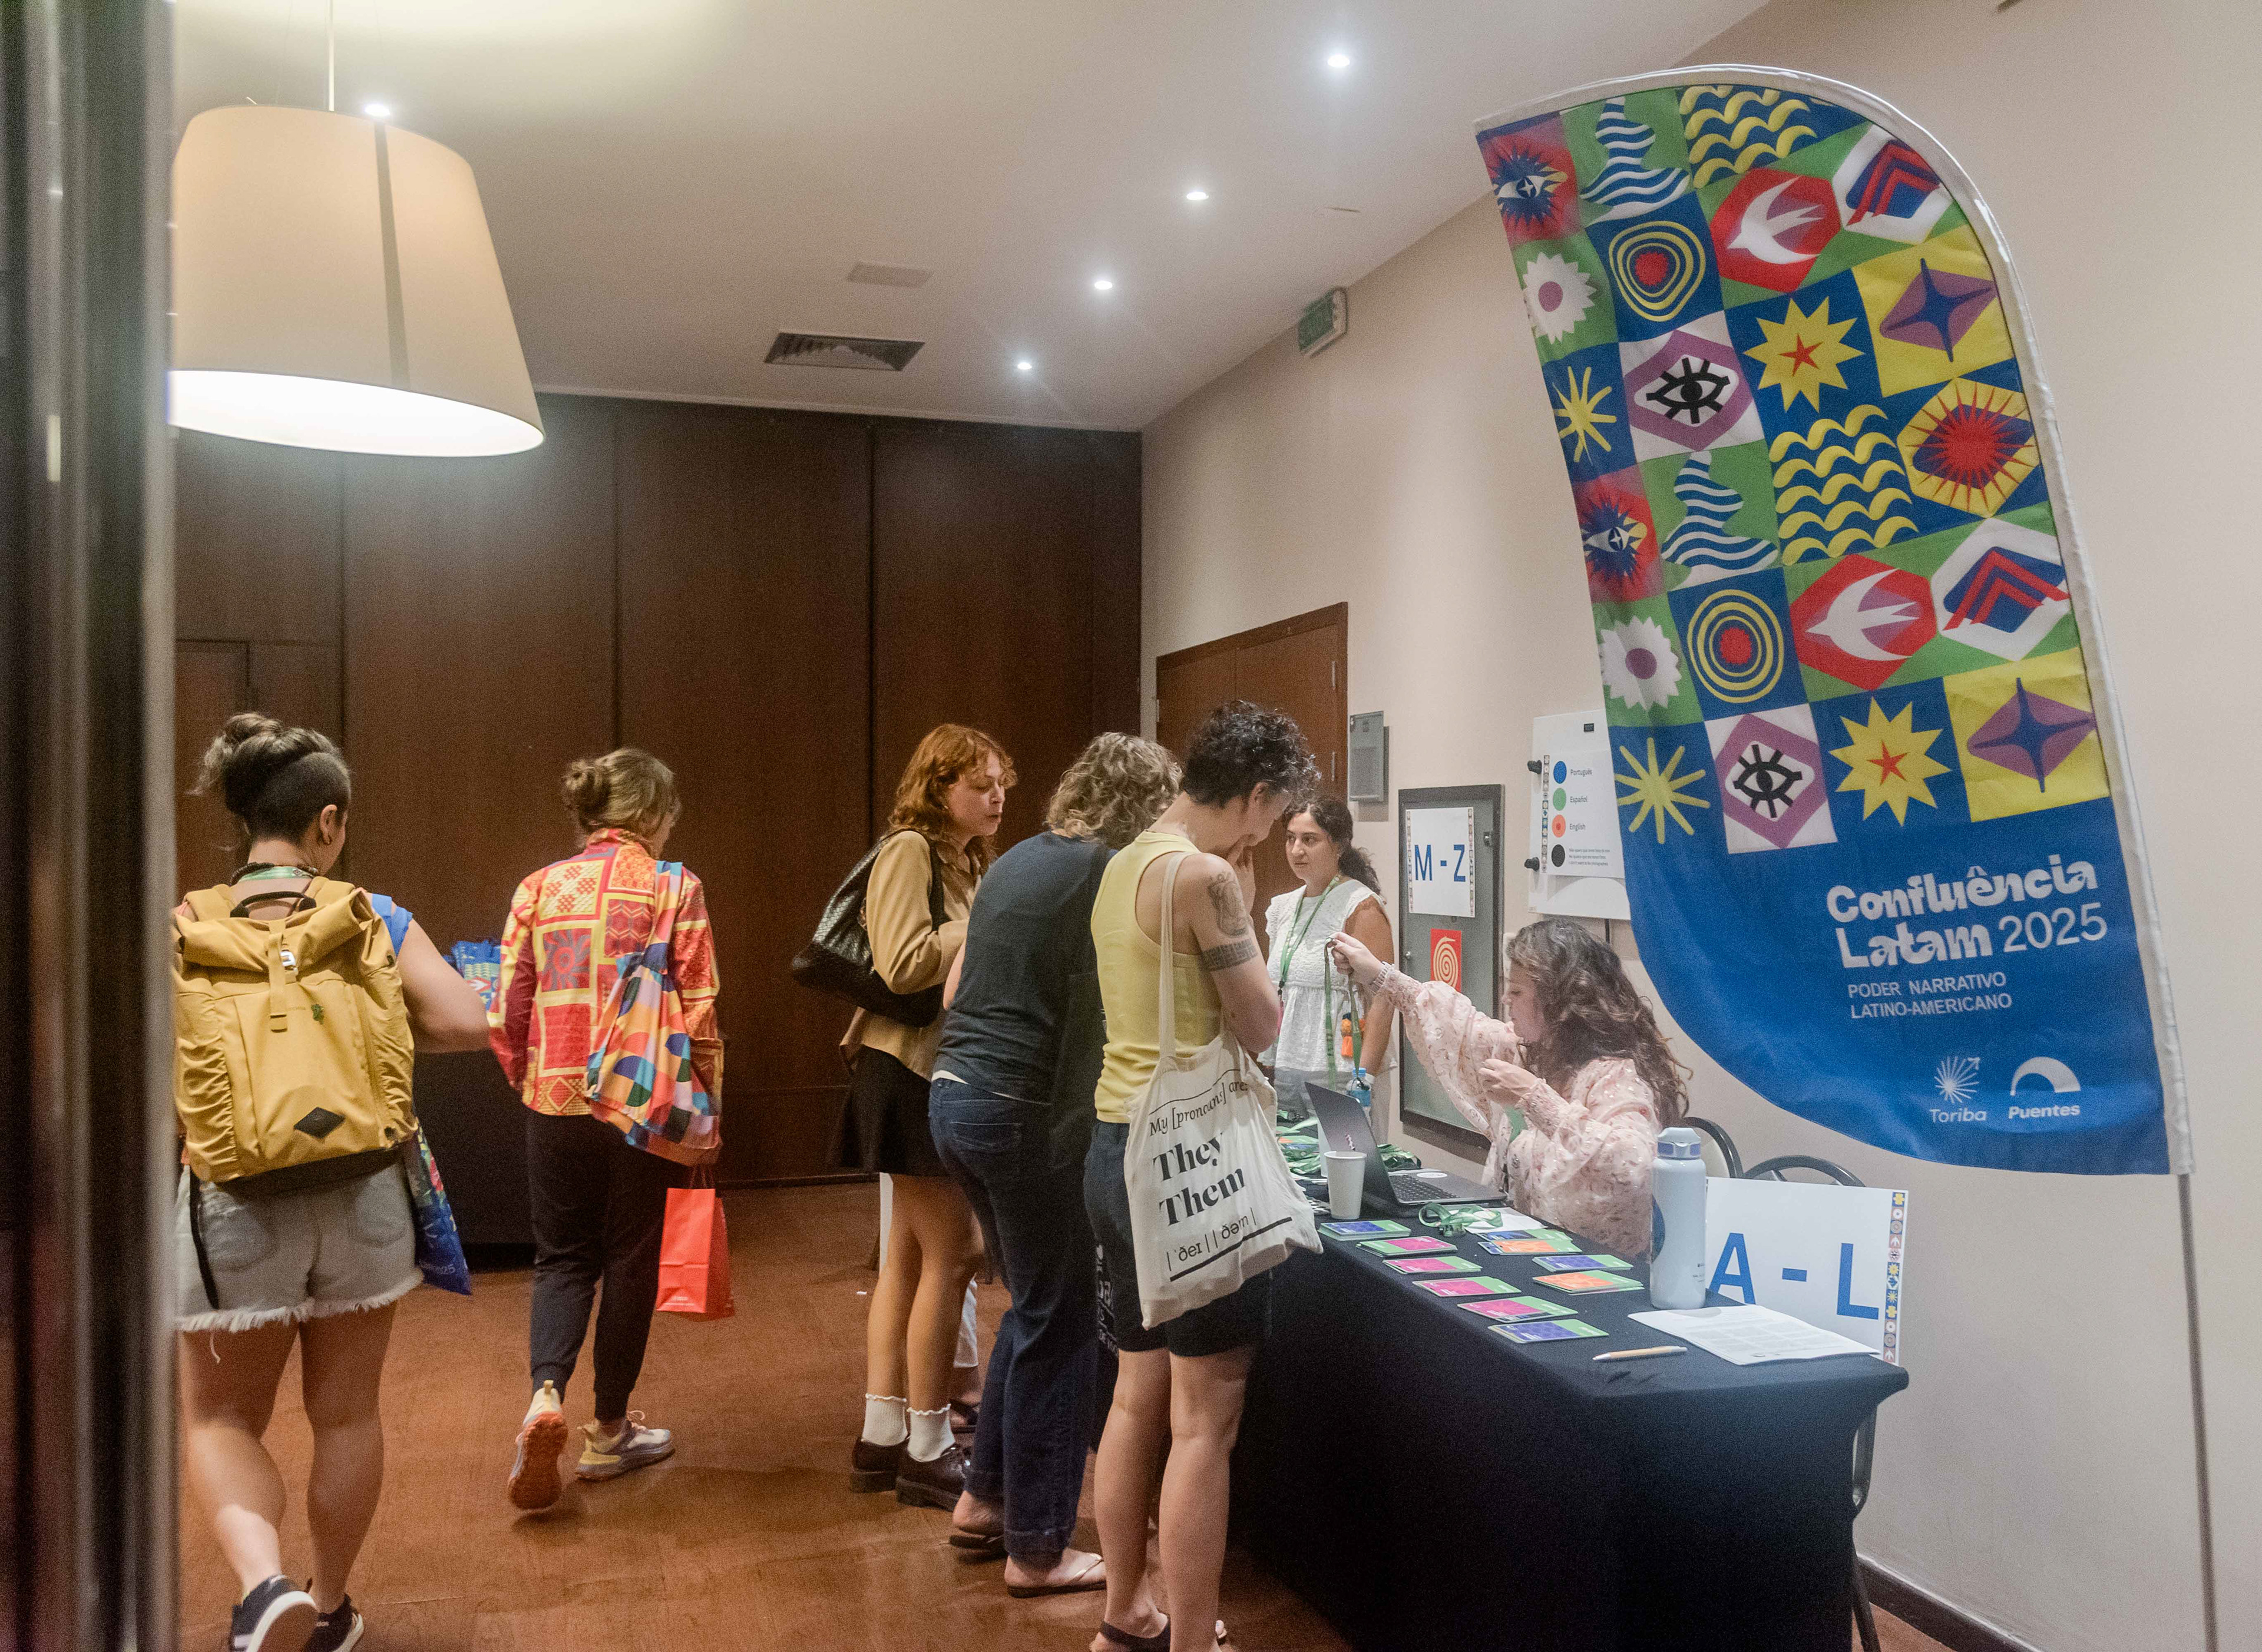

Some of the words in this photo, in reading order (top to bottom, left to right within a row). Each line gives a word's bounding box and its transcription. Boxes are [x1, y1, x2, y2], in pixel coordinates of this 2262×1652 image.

[1570, 768, 1592, 777] Português
[1569, 796, 1588, 805] Español
[1569, 823, 1586, 832] English
[1414, 844, 1433, 881] M
[1453, 844, 1466, 882] Z
[1826, 854, 2098, 922] Confluência
[1835, 921, 1993, 968] Latam
[1998, 902, 2108, 952] 2025
[1848, 981, 1901, 998] PODER
[1909, 971, 2006, 992] NARRATIVO
[1850, 993, 2012, 1019] LATINO-AMERICANO
[1150, 1117, 1168, 1137] My
[1929, 1107, 1987, 1123] Toriba
[2008, 1104, 2081, 1119] Puentes
[1153, 1132, 1223, 1183] They
[1159, 1168, 1245, 1226] Them
[1709, 1232, 1757, 1305] A
[1836, 1242, 1880, 1320] L
